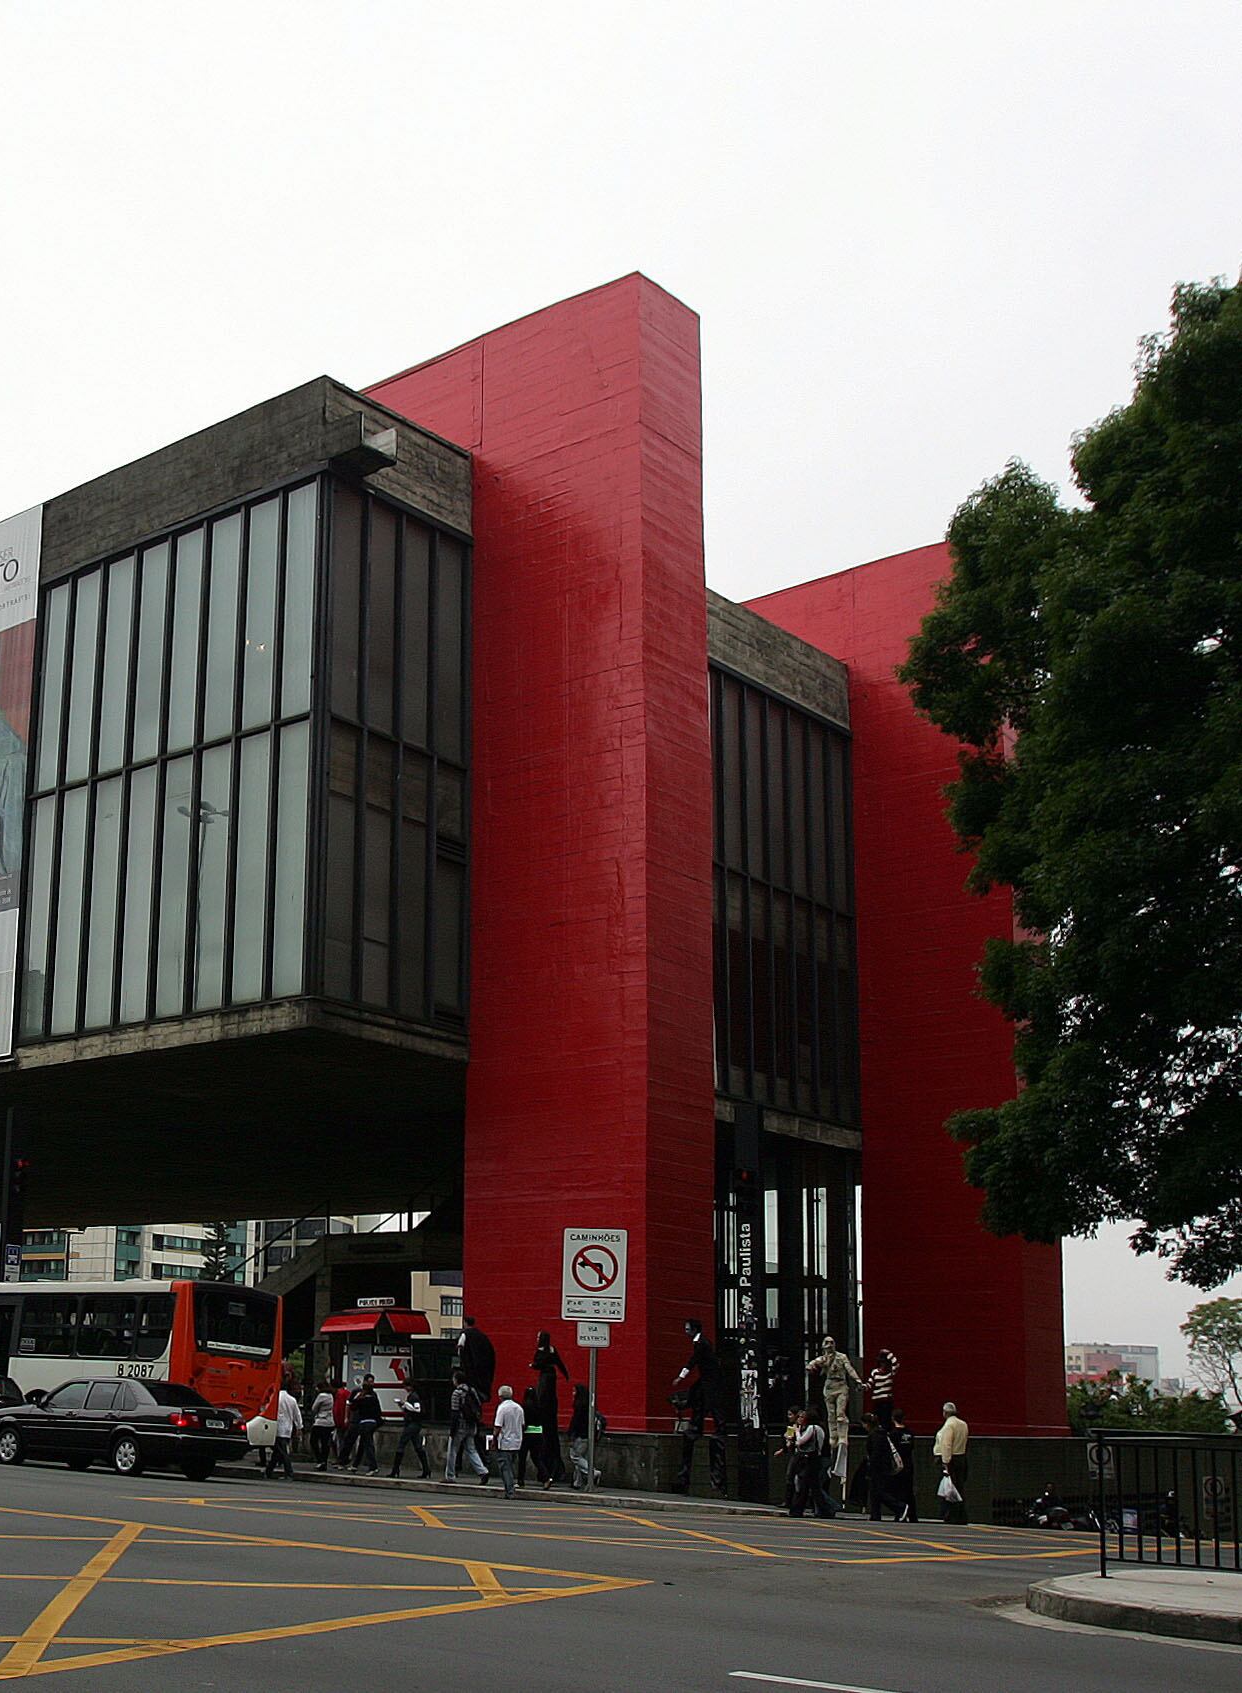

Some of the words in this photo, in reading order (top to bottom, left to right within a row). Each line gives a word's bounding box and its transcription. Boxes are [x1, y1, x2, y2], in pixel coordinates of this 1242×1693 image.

[570, 1233, 621, 1242] CAMINHÕES
[739, 1223, 752, 1287] Paulista
[117, 1363, 124, 1376] 8
[127, 1364, 154, 1377] 2087
